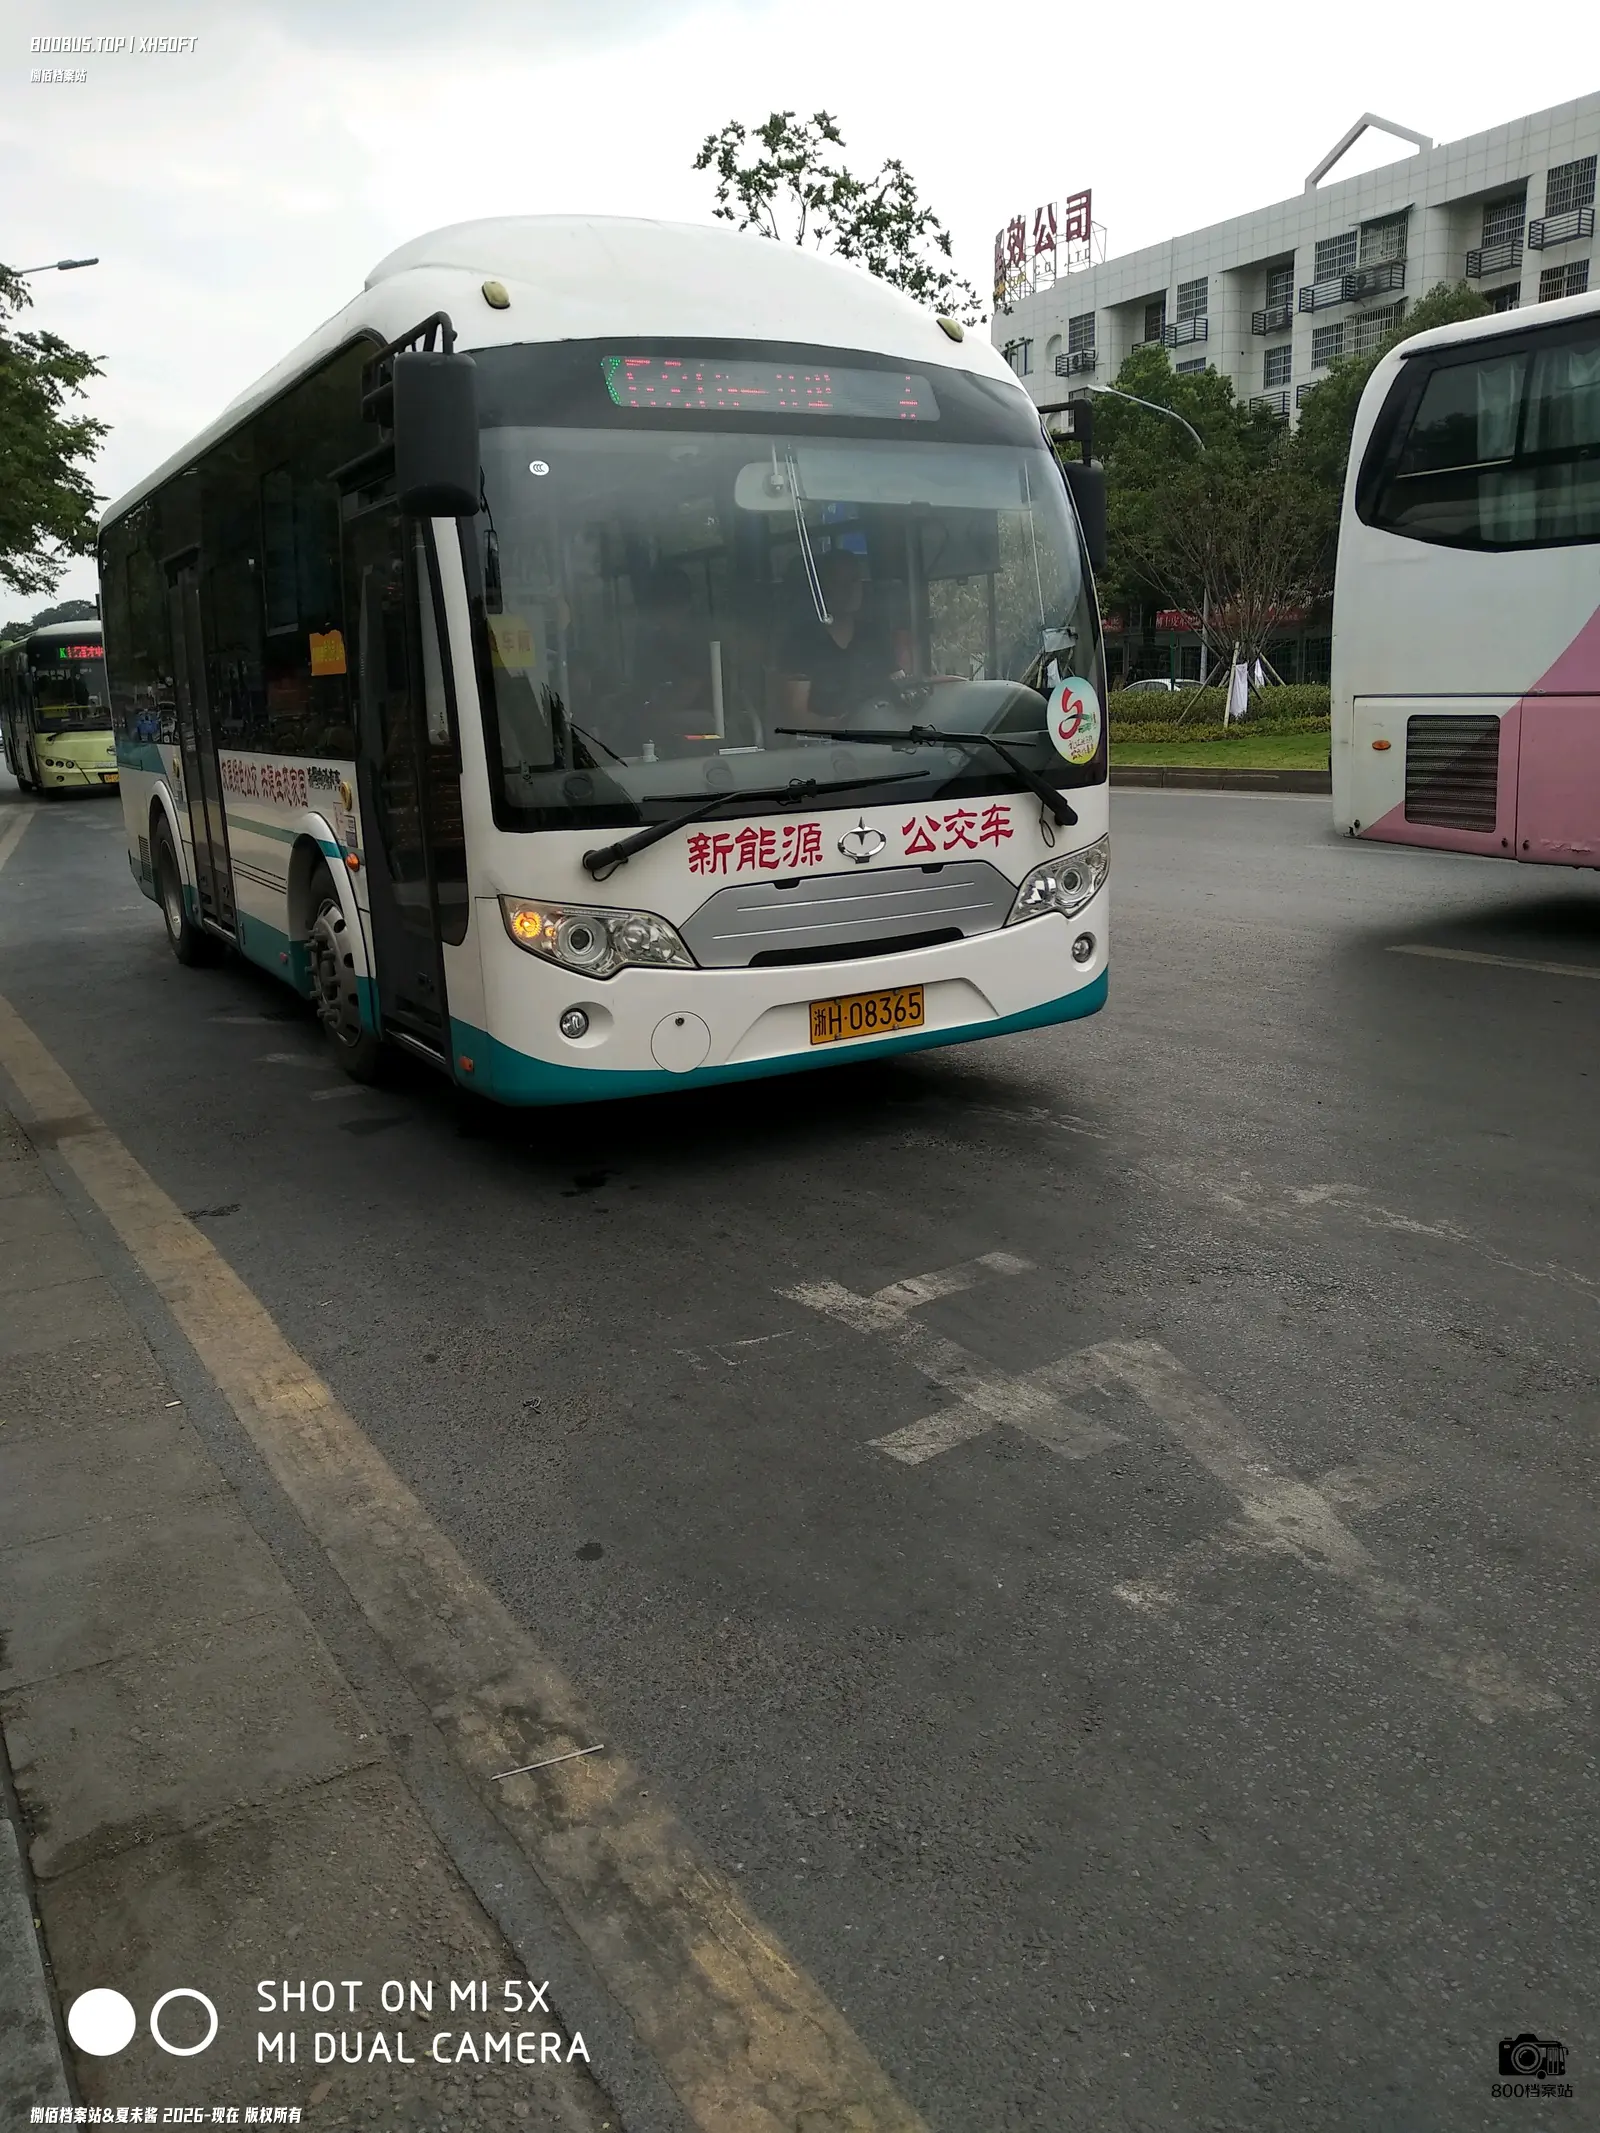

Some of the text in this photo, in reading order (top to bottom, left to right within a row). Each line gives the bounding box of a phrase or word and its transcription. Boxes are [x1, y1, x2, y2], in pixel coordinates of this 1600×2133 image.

[687, 804, 1014, 876] 新能源 公交车
